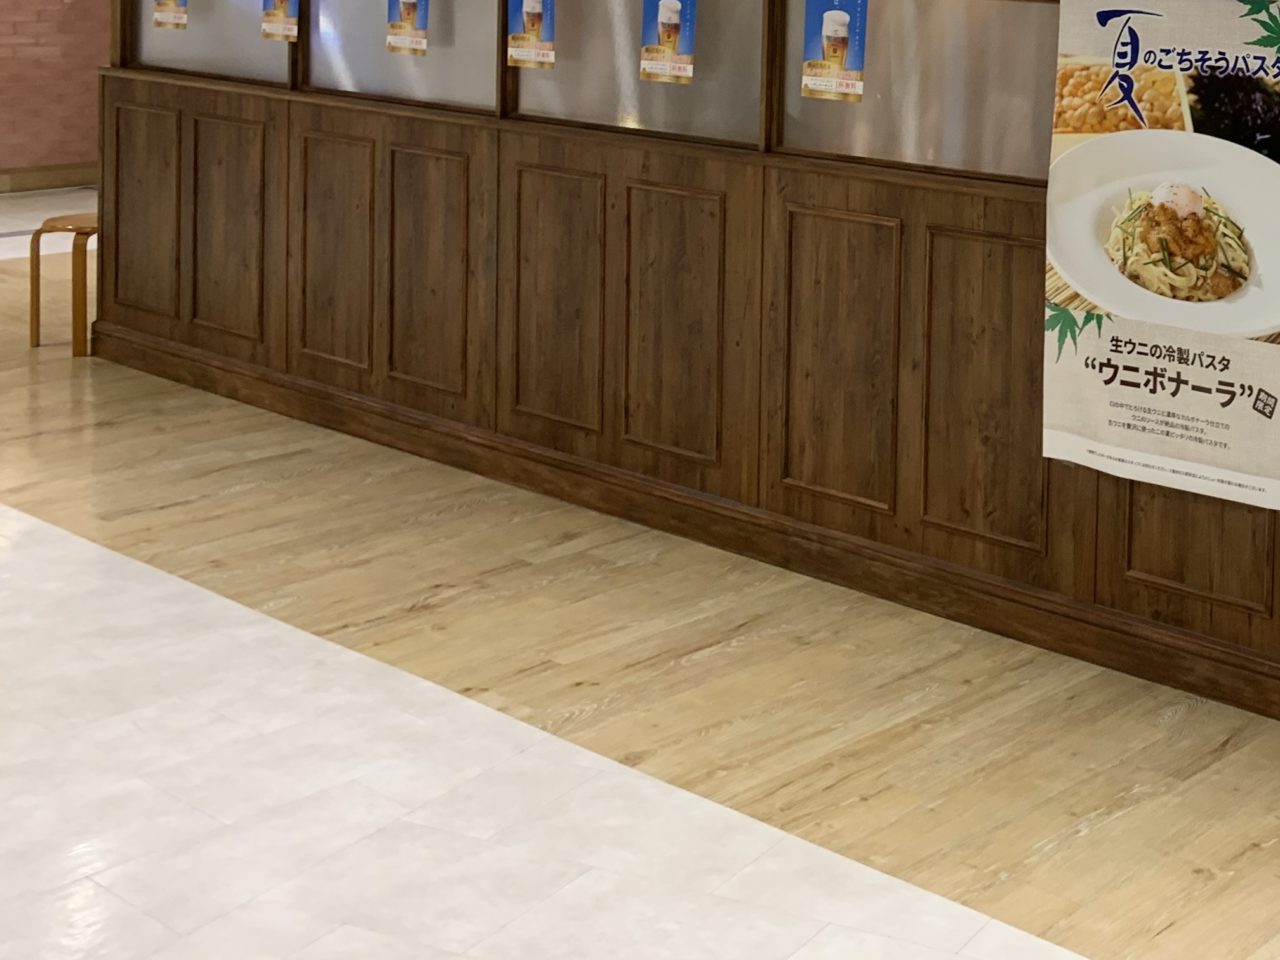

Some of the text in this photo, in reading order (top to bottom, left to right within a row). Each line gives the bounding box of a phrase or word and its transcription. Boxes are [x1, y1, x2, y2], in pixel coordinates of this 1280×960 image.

[1109, 335, 1231, 373] 生ウニの冷製パスタ
